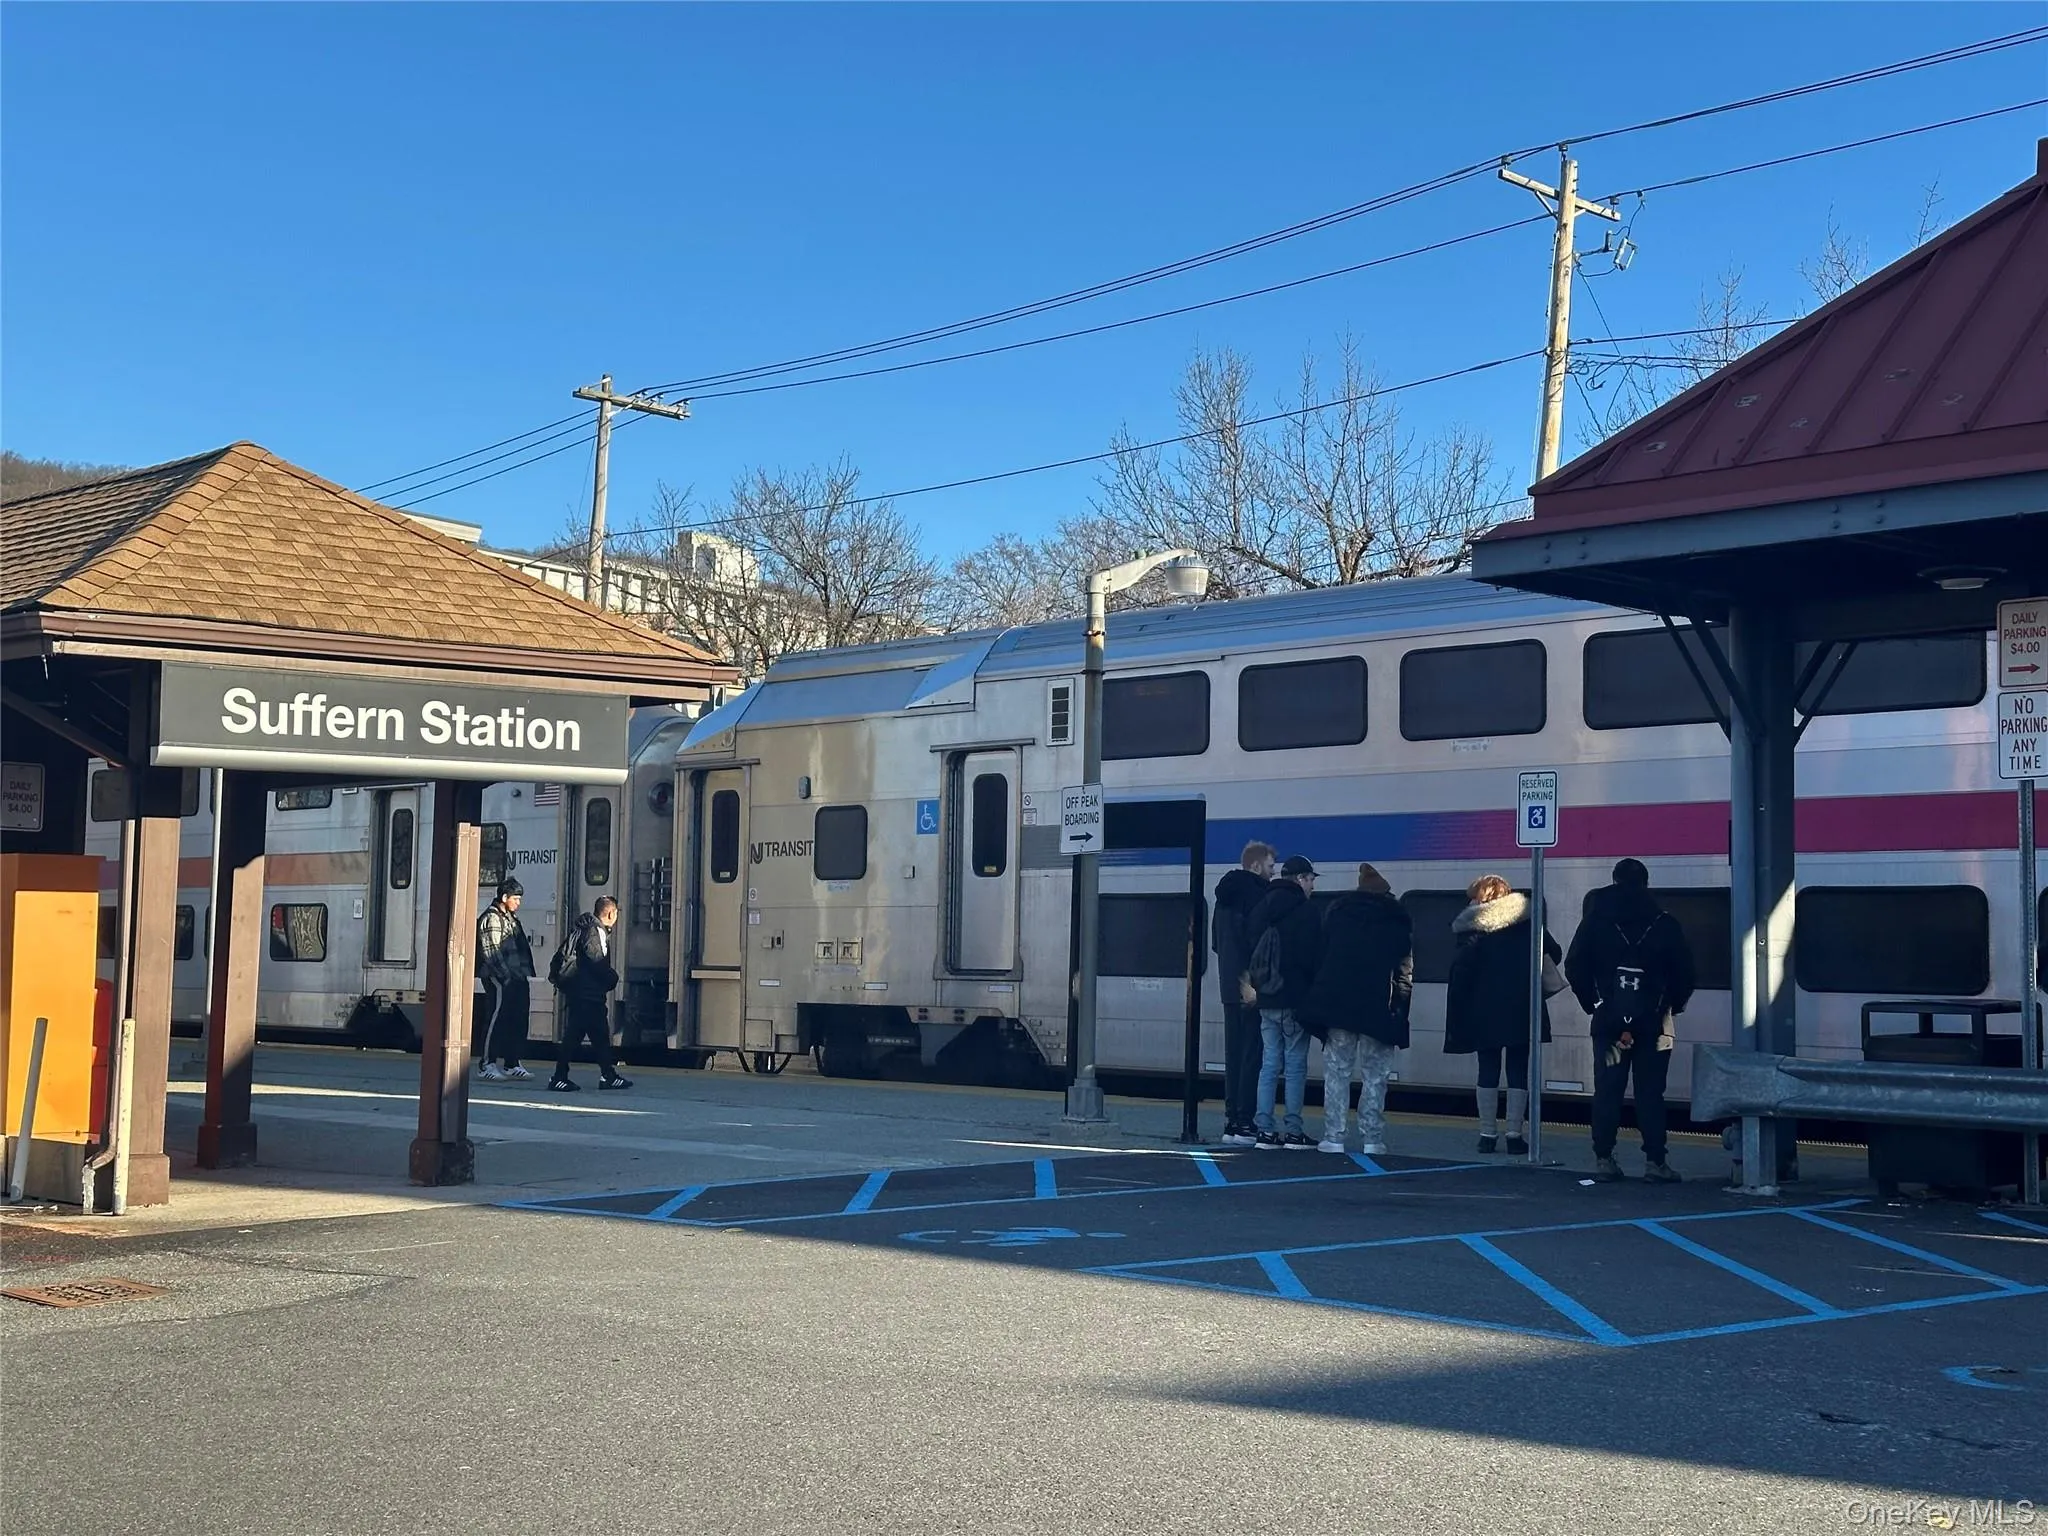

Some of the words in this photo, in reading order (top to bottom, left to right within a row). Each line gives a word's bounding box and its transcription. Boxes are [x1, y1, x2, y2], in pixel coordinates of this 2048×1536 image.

[2012, 611, 2038, 625] DAILY
[2003, 626, 2046, 641] PARKING
[2010, 641, 2040, 655] $4.00
[2014, 697, 2034, 715] NO
[220, 687, 405, 741] Suffern
[419, 700, 581, 751] Station
[2001, 716, 2047, 735] PARKING
[2012, 738, 2037, 753] ANY
[2009, 755, 2041, 770] TIME
[1521, 779, 1554, 789] RESERVED
[2, 791, 38, 802] PARKING
[1065, 796, 1079, 809] OFF
[1080, 794, 1099, 807] PEAK
[1521, 791, 1553, 801] PARKING
[1064, 811, 1100, 826] BOARDING
[517, 849, 558, 865] TRANSIT
[749, 841, 764, 865] NJ
[764, 840, 814, 857] TRANSIT
